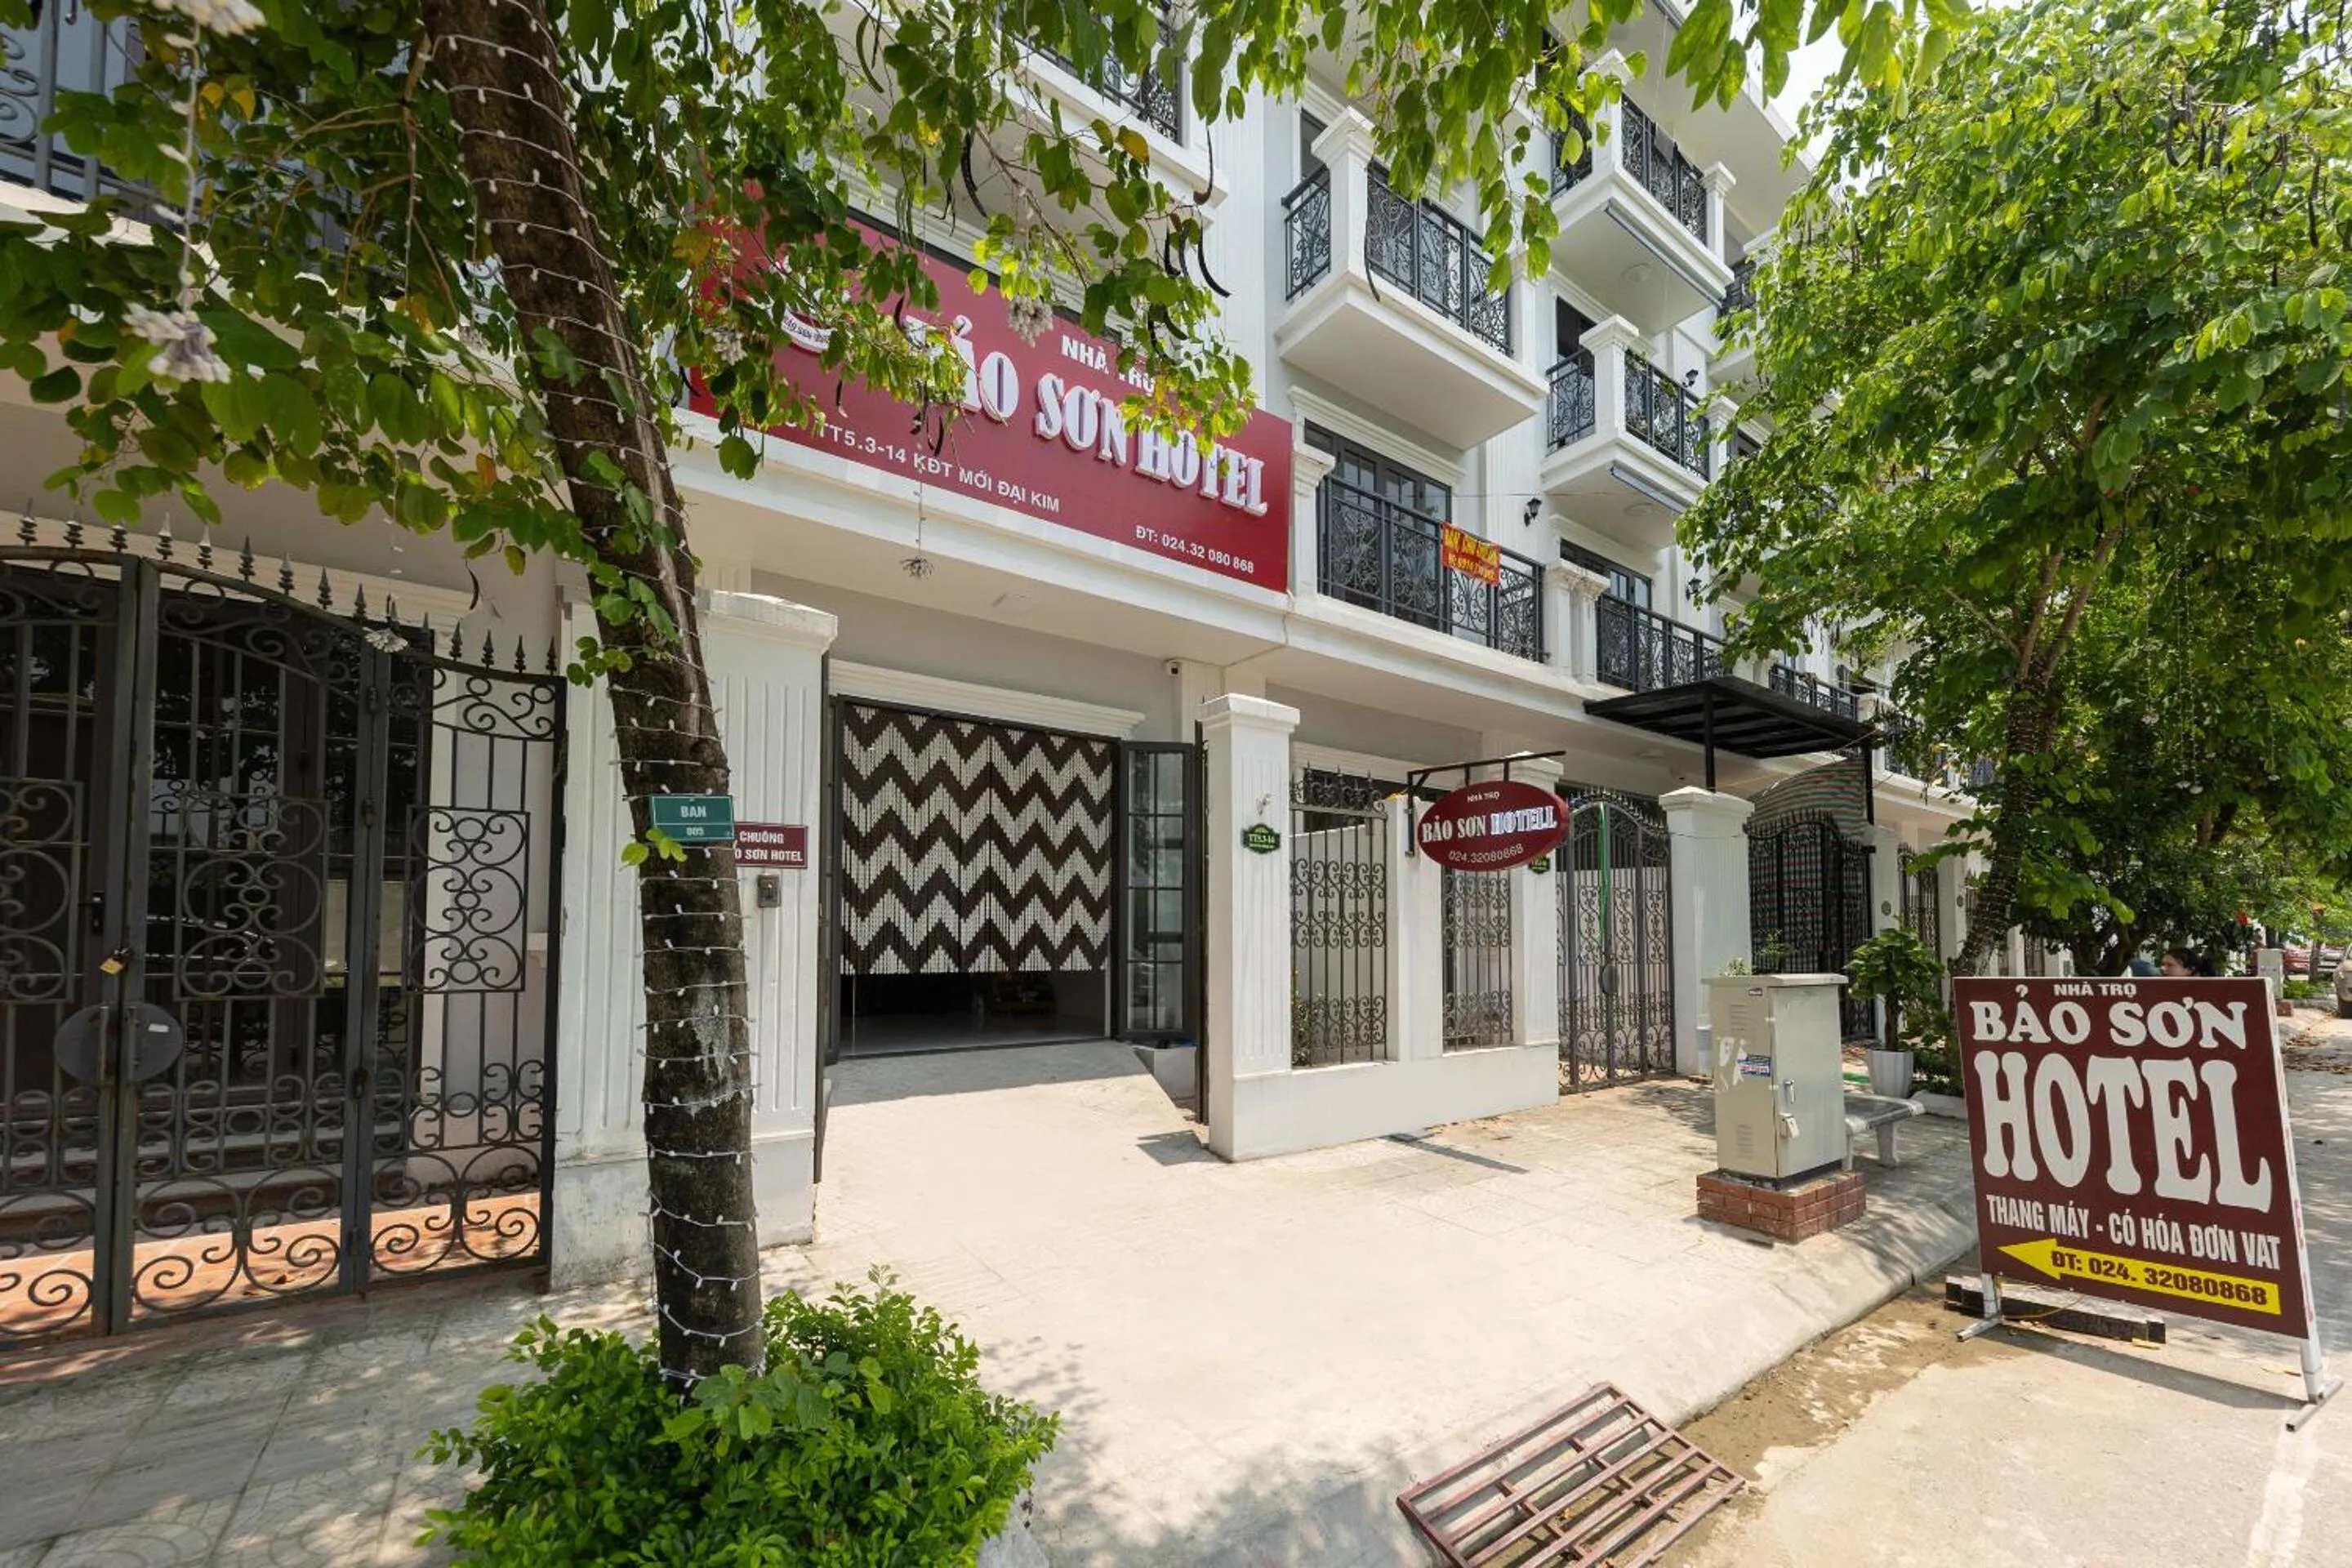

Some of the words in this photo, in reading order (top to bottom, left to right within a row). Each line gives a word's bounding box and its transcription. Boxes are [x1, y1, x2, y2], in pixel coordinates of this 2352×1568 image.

[1062, 335, 1109, 374] NHÀ
[1116, 358, 1156, 397] RỌ
[1036, 372, 1127, 466] SƠN
[1135, 416, 1267, 516] HOTEL
[914, 453, 952, 479] KĐT
[959, 466, 992, 492] MỚI
[997, 480, 1026, 504] ĐẠI
[1031, 492, 1060, 513] KIM
[1136, 525, 1158, 542] ĐT:
[1161, 533, 1205, 559] 024.32
[1209, 547, 1230, 567] 080
[1232, 553, 1254, 573] 868
[680, 805, 707, 818] BAN
[1422, 815, 1453, 843] BẢO
[1458, 814, 1487, 839] SƠN
[771, 850, 804, 862] HOTEL
[1449, 843, 1524, 864] 024.32080868
[1969, 984, 2091, 1045] BẢO
[2109, 996, 2247, 1050] SƠN
[2054, 981, 2094, 996] NHÀ
[2099, 982, 2136, 998] TRỌ
[1974, 1050, 2273, 1214] HOTEL
[1986, 1194, 2045, 1232] THANG
[2049, 1200, 2090, 1239] MÁY
[2109, 1209, 2136, 1247] CÓ
[2140, 1213, 2185, 1256] HÓA
[2189, 1223, 2238, 1263] ĐƠN
[2241, 1232, 2281, 1271] VAT
[2051, 1250, 2082, 1272] ĐT:
[2088, 1258, 2137, 1282] 024.
[2144, 1266, 2267, 1306] 32080868
